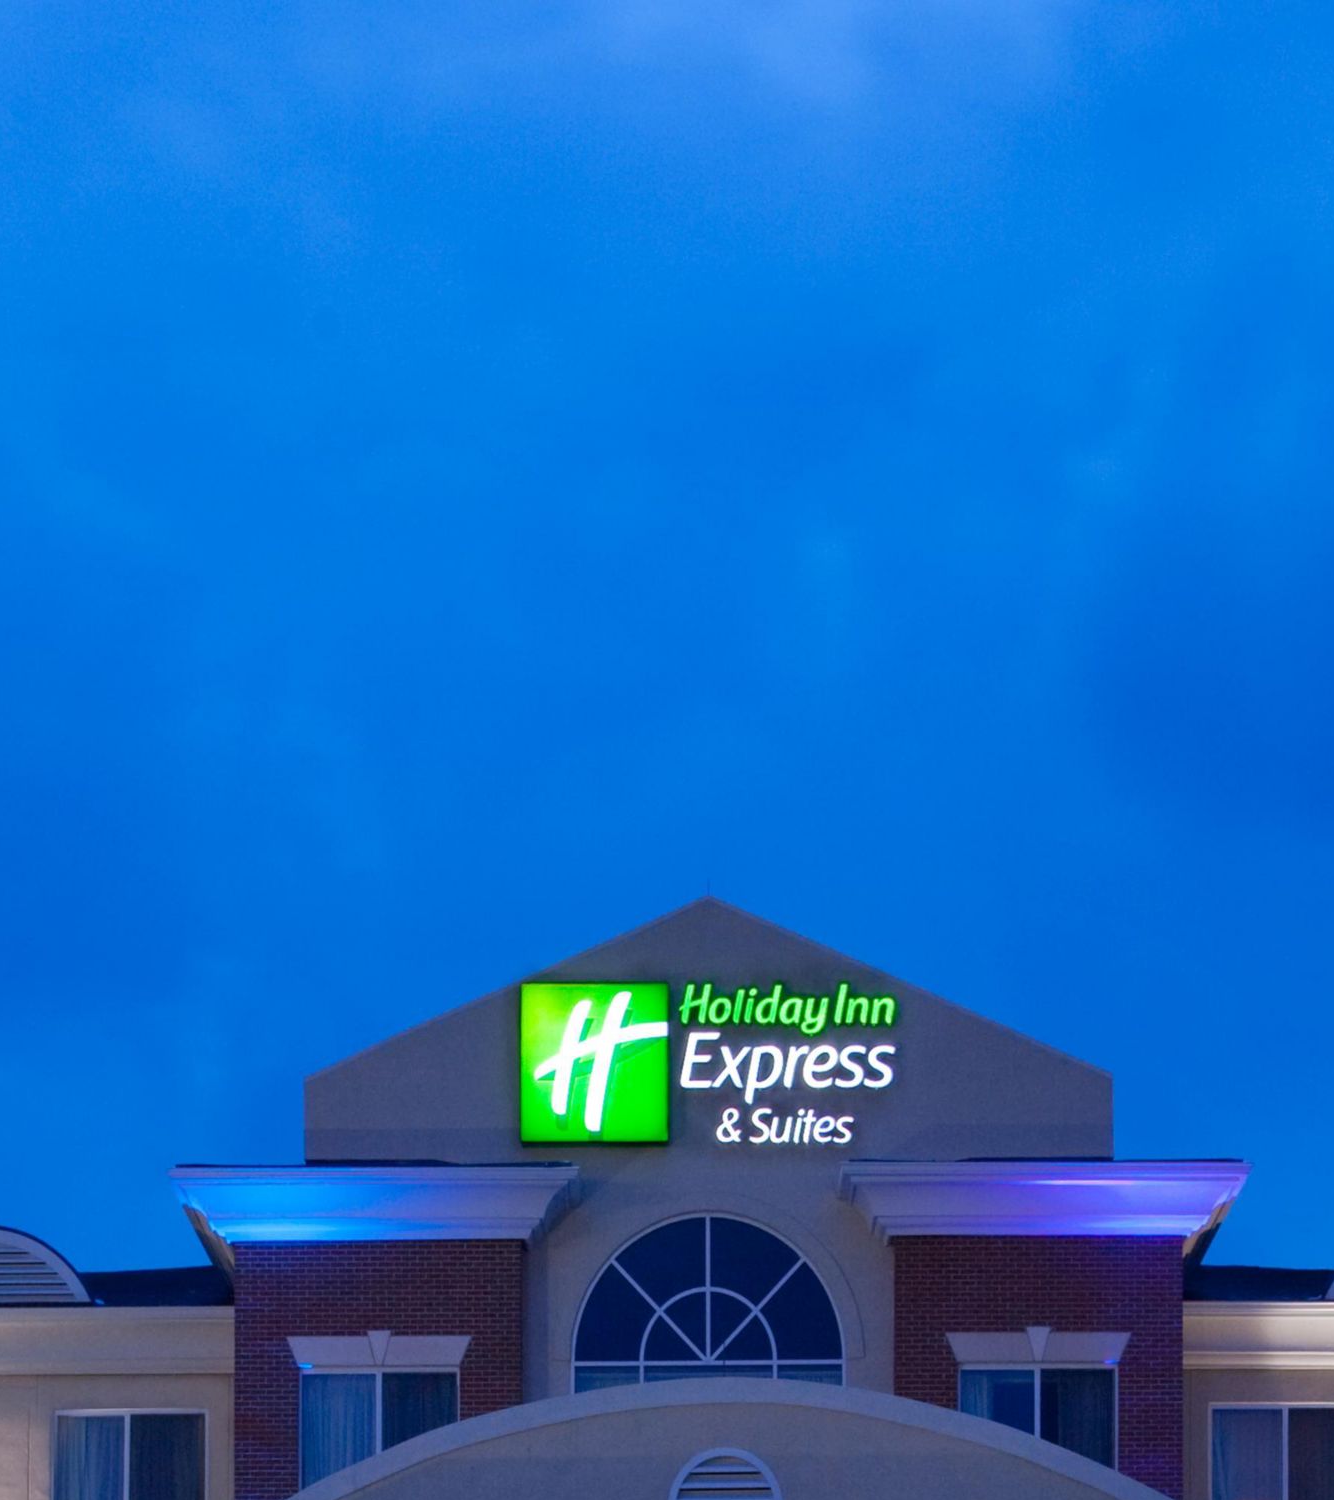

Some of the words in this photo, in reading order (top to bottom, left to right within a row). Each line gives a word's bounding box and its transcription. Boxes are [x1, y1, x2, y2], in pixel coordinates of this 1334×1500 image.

[679, 983, 829, 1034] Holiday
[833, 983, 895, 1026] Inn
[679, 1031, 896, 1104] Express
[715, 1107, 743, 1144] &
[749, 1107, 854, 1145] Suites
